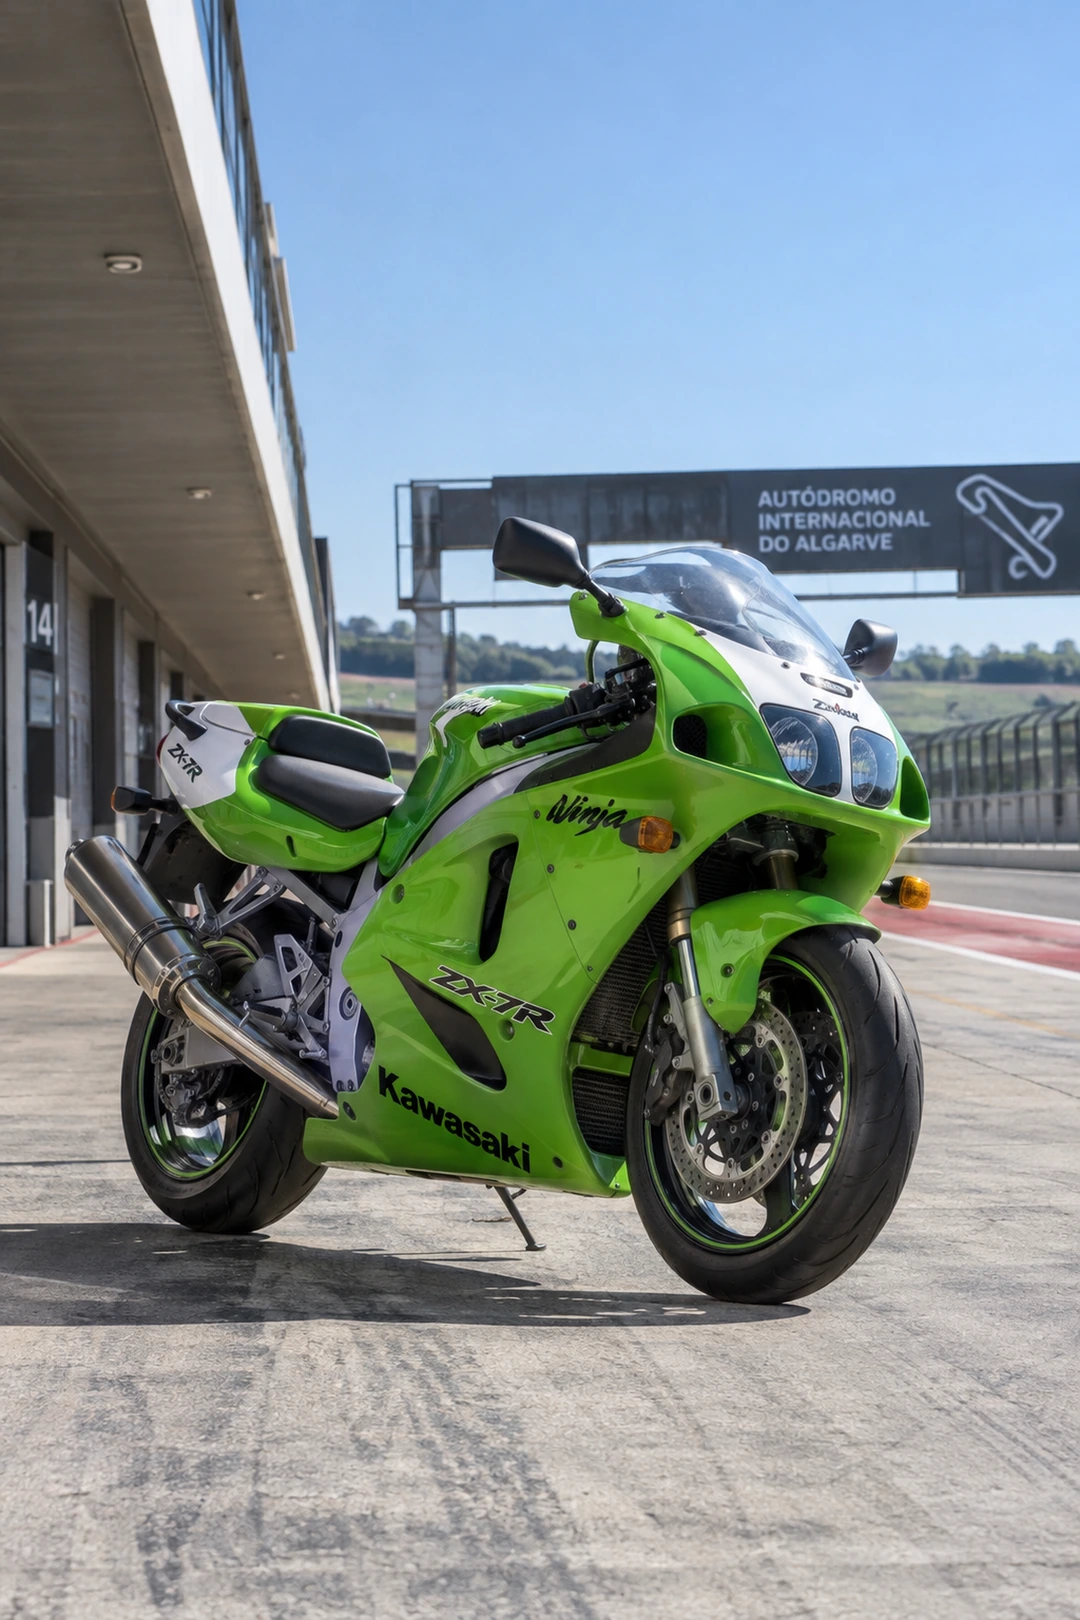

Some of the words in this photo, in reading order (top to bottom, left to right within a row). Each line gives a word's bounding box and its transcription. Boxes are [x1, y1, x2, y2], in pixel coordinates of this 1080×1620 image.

[758, 486, 896, 508] AUTÓDROMO
[758, 510, 931, 530] INTERNACIONAL
[759, 535, 790, 552] DO
[795, 533, 893, 552] ALGARVE
[27, 600, 53, 646] 14
[167, 743, 203, 783] ZX-7R
[546, 794, 628, 836] Ninja
[429, 965, 556, 1035] ZX-7R
[378, 1065, 531, 1174] Kawasaki
